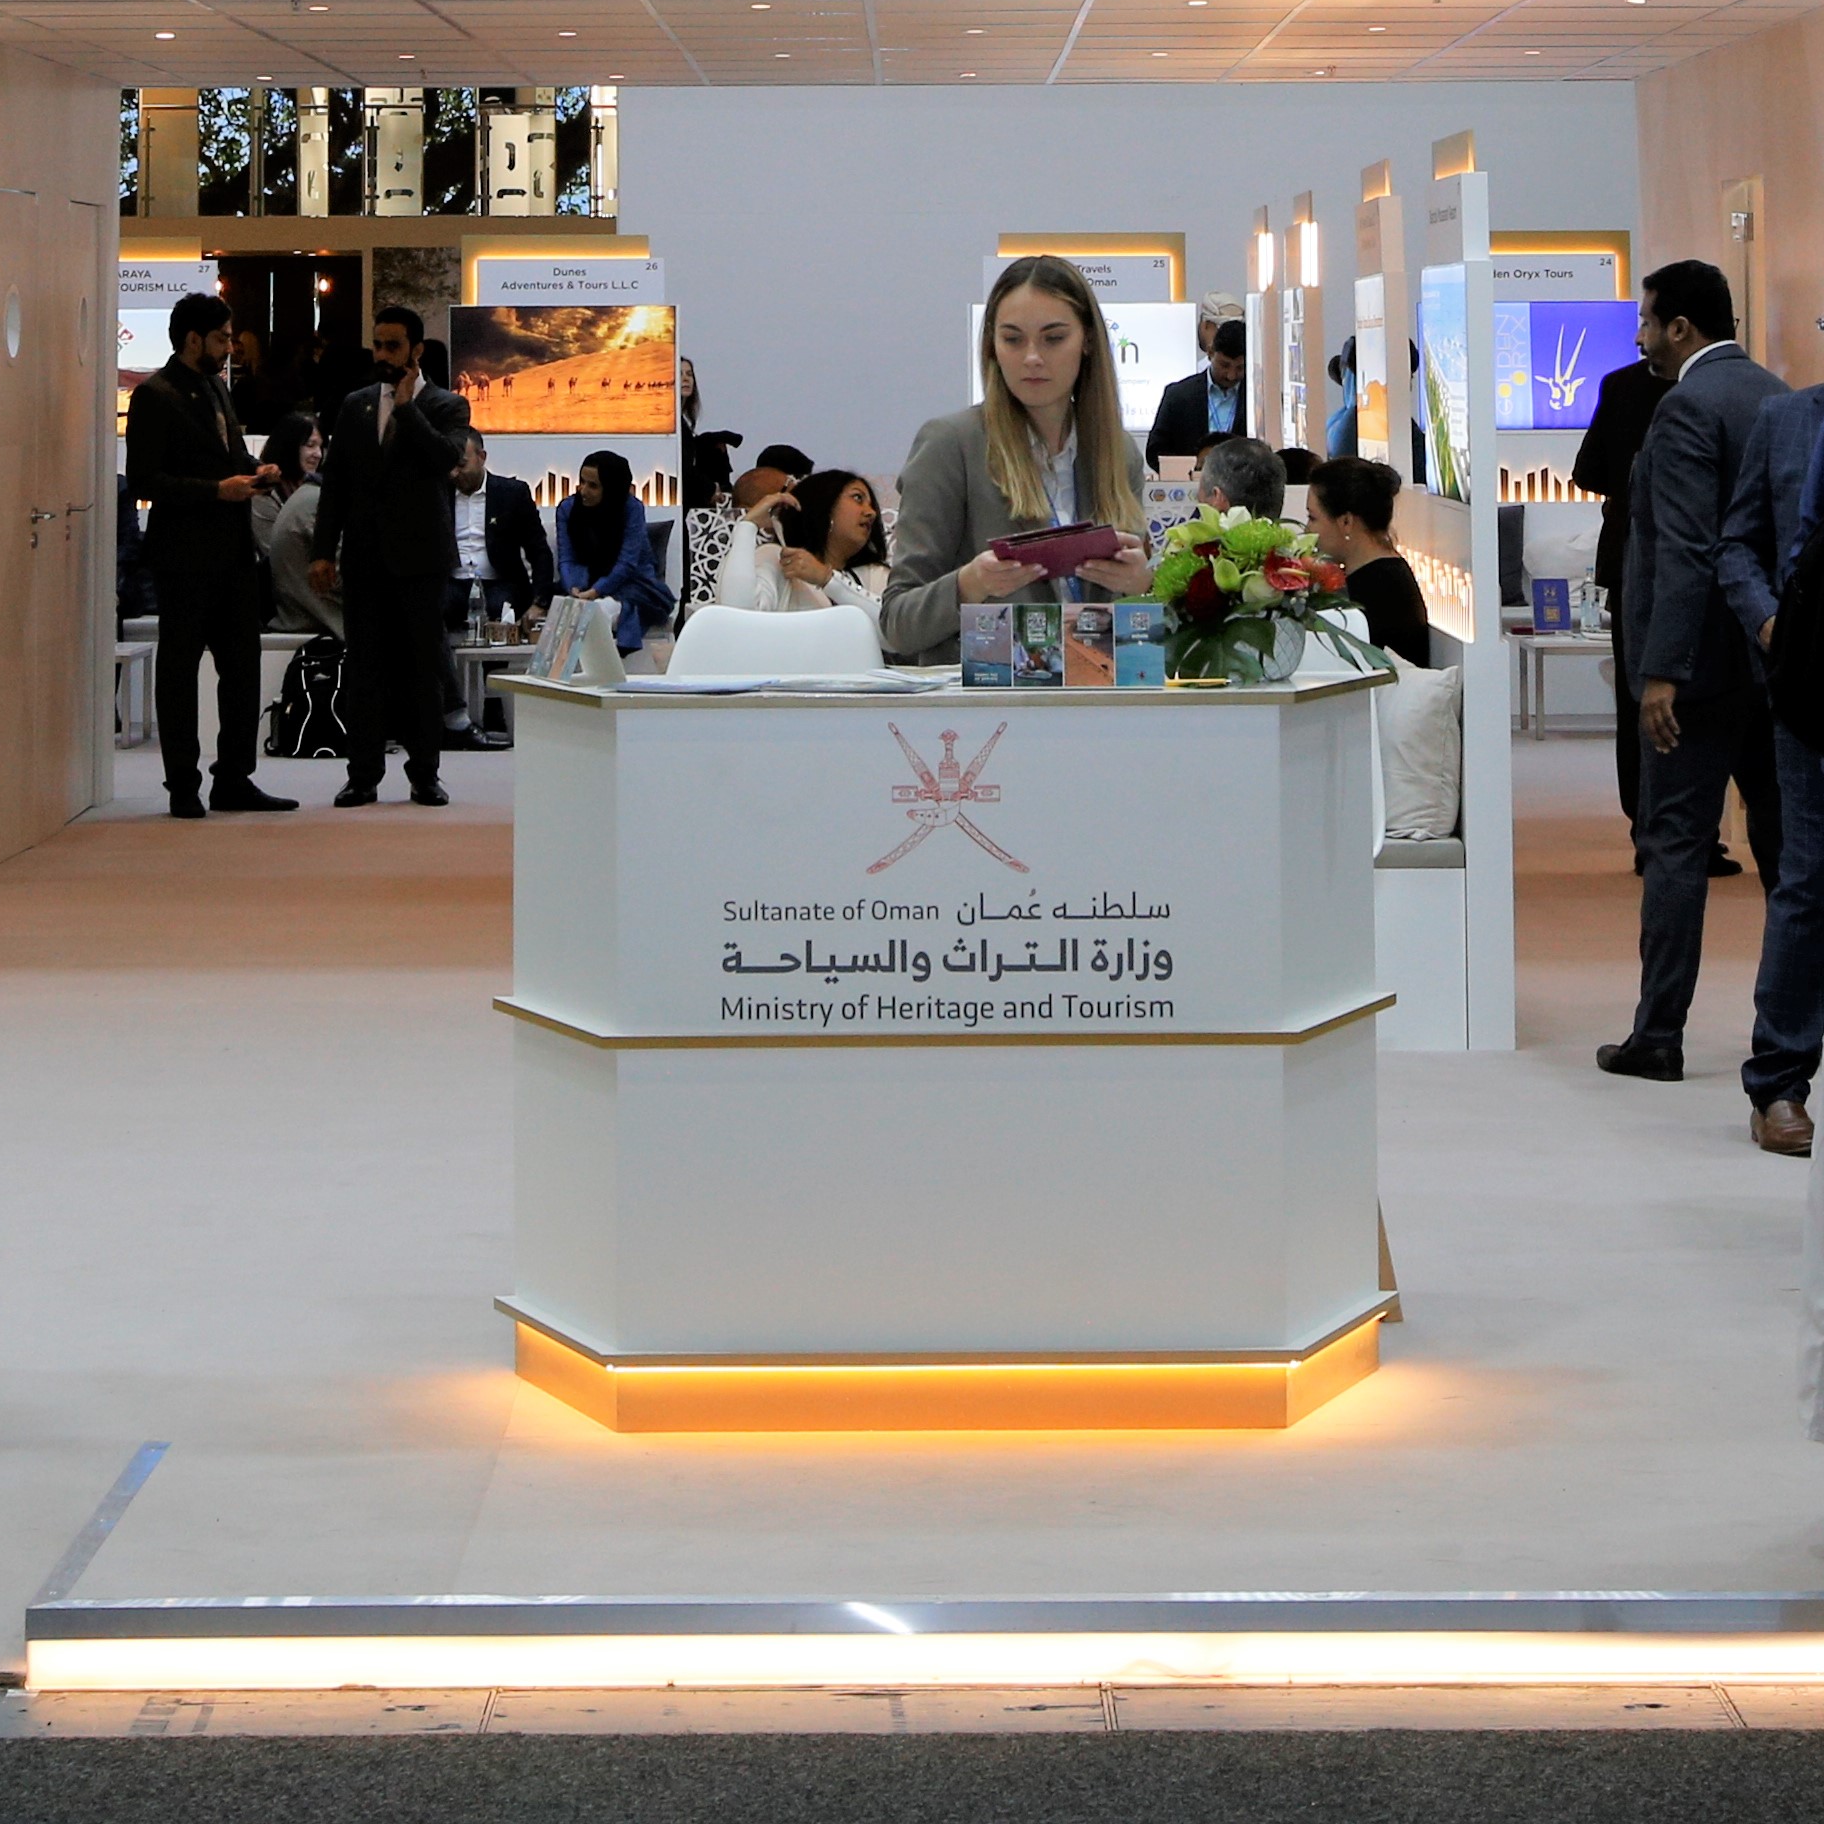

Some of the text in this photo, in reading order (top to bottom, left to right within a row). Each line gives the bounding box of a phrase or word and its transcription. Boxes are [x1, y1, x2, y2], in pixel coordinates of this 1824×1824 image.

[1152, 259, 1166, 268] 25
[1599, 258, 1612, 266] 24
[198, 265, 210, 273] 27
[645, 263, 658, 271] 26
[553, 267, 587, 277] Dunes
[1513, 269, 1540, 280] Oryx
[1544, 269, 1574, 278] Tours
[119, 283, 188, 292] OURISM LLC
[501, 281, 564, 290] Adventures
[567, 281, 574, 290] &
[578, 281, 608, 290] Tours
[723, 898, 939, 922] Sultanate of Oman
[722, 937, 1173, 985] وزارة التراث والسياحة
[721, 993, 1174, 1028] Ministry of Heritage and Tourism
